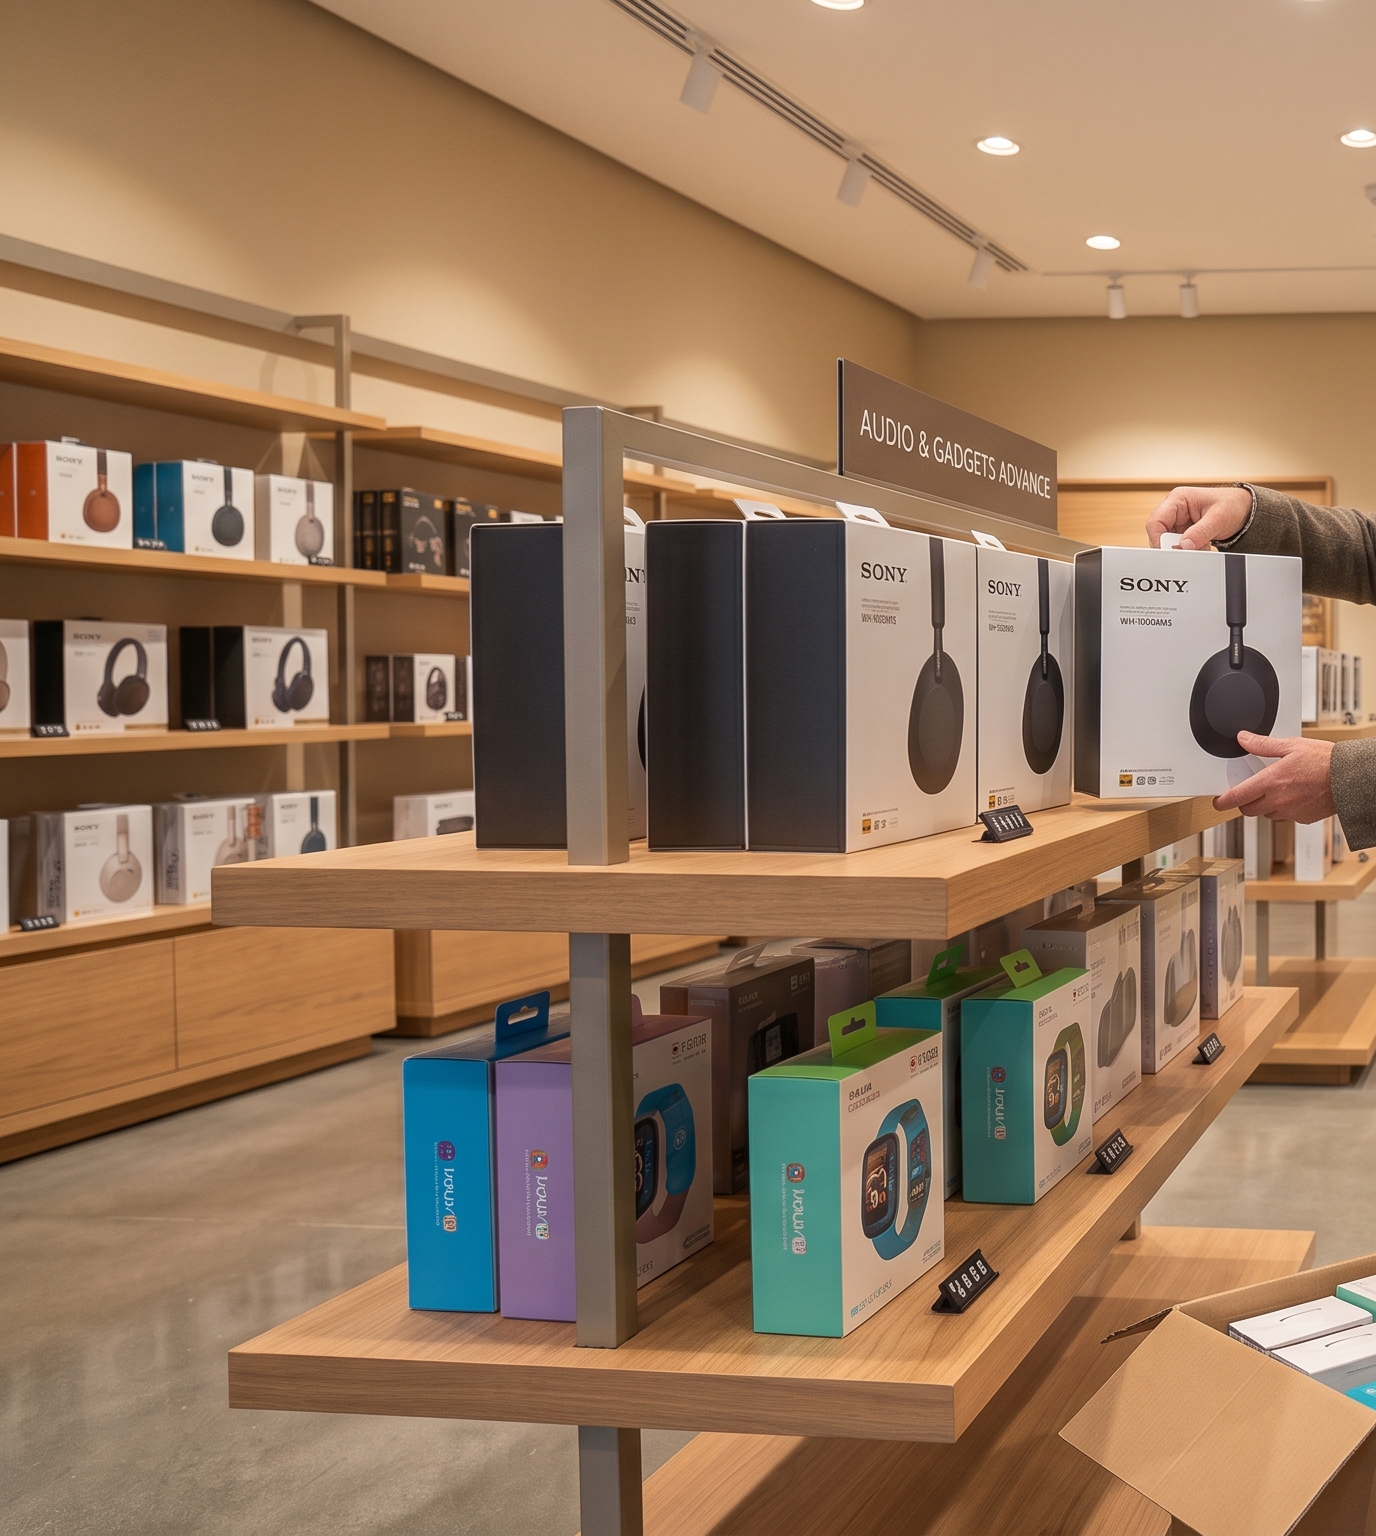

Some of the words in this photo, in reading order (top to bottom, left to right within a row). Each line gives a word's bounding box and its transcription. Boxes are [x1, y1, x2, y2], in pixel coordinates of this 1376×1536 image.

[860, 409, 914, 453] AUDIO
[919, 430, 930, 459] &
[933, 435, 996, 481] GADGETS
[998, 459, 1051, 499] ADVANCE
[861, 562, 908, 583] SONY
[988, 579, 1022, 597] SONY
[1119, 577, 1189, 593] SONY
